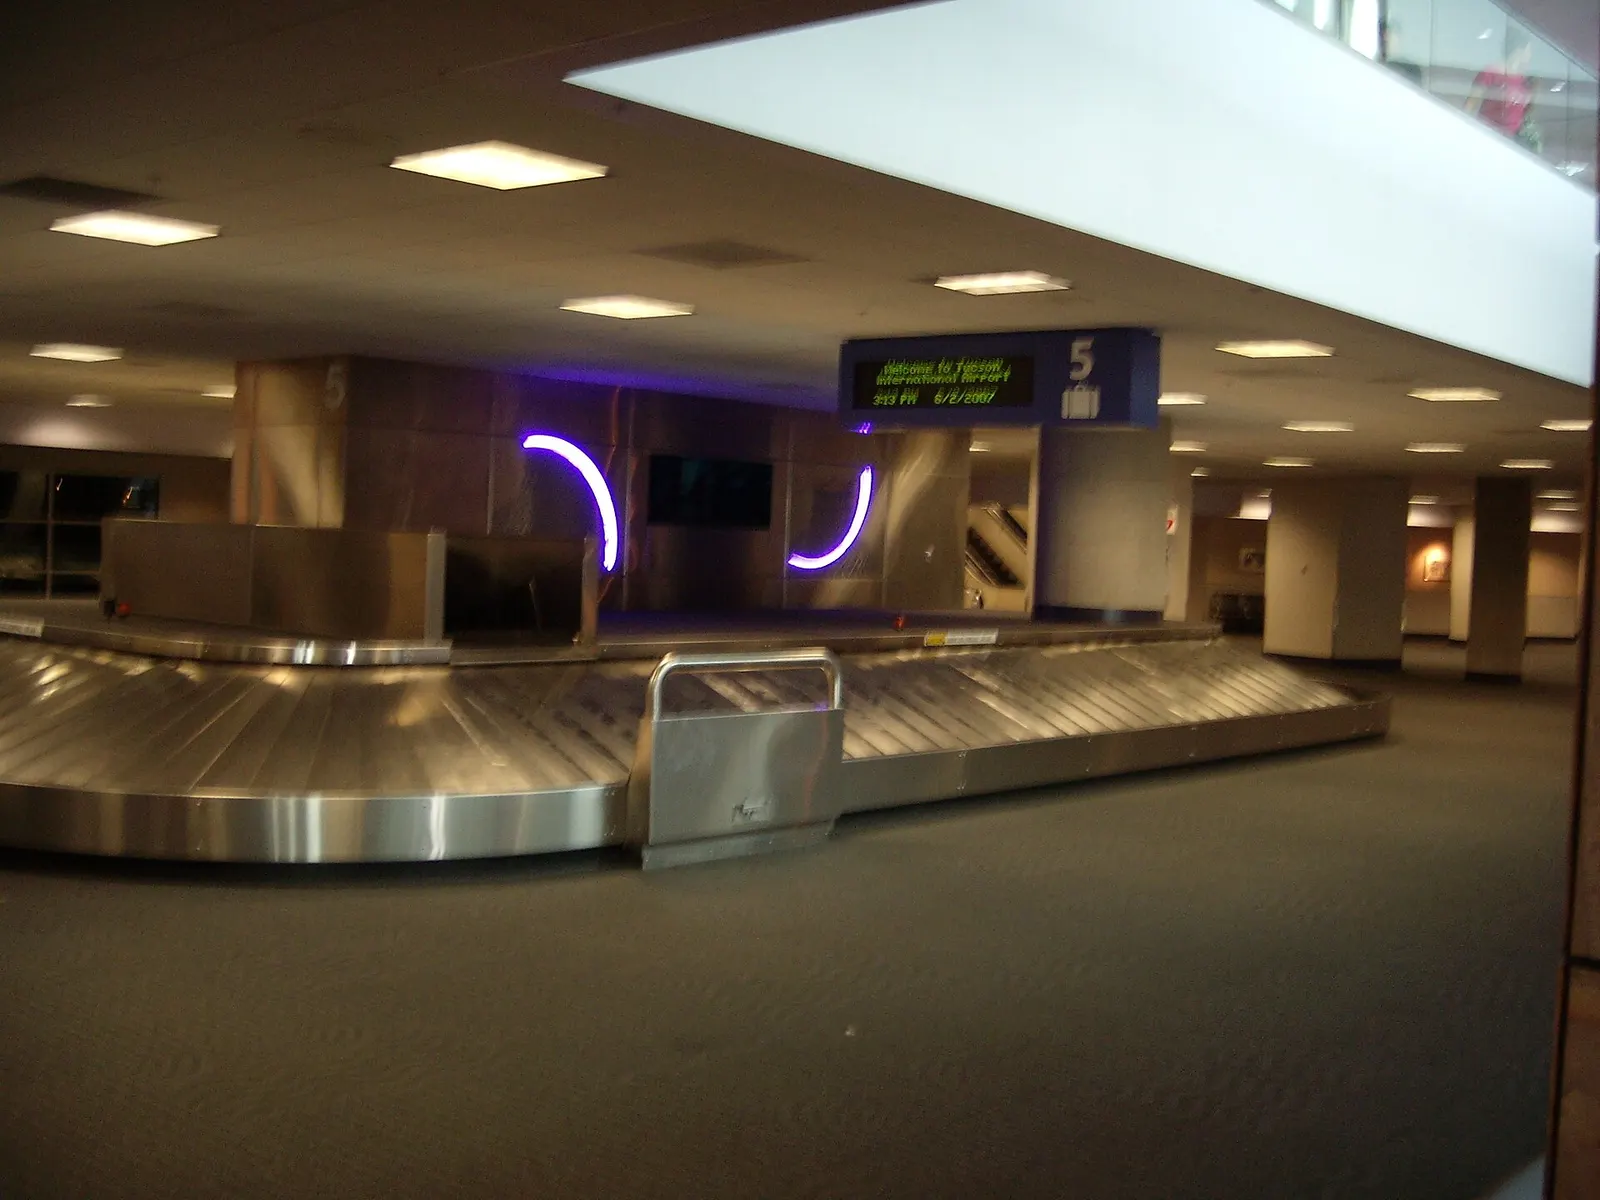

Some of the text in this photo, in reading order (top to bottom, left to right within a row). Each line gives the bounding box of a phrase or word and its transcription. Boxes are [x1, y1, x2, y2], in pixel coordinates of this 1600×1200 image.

[883, 361, 933, 376] Welcome
[956, 359, 1002, 374] Tucson
[1069, 336, 1095, 381] 5
[876, 367, 1011, 386] International Airport
[325, 364, 346, 409] 5
[899, 392, 918, 405] PM
[933, 389, 997, 405] 6/2/2007
